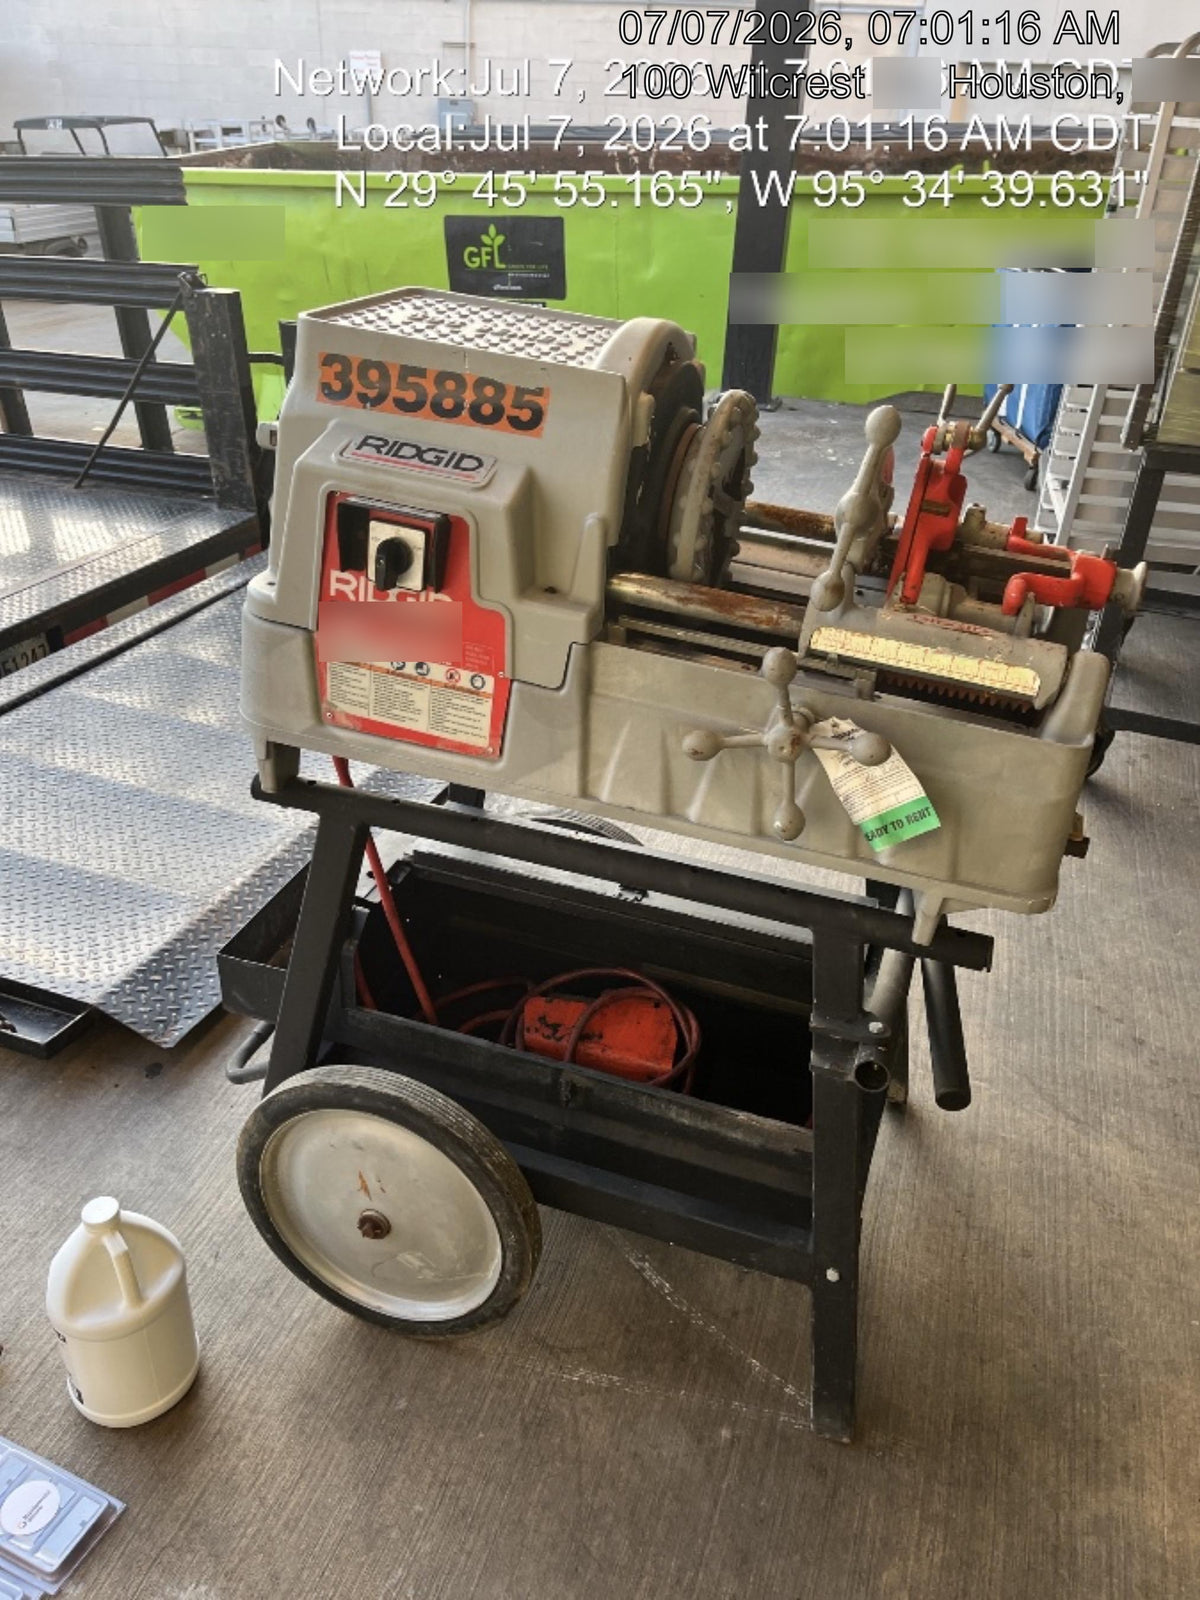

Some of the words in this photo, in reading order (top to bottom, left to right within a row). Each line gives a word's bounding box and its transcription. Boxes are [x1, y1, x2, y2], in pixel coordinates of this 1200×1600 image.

[463, 235, 507, 269] GFL
[320, 352, 545, 431] 395885
[355, 434, 484, 473] RIDGID
[891, 818, 905, 832] TO
[905, 806, 932, 825] RENT
